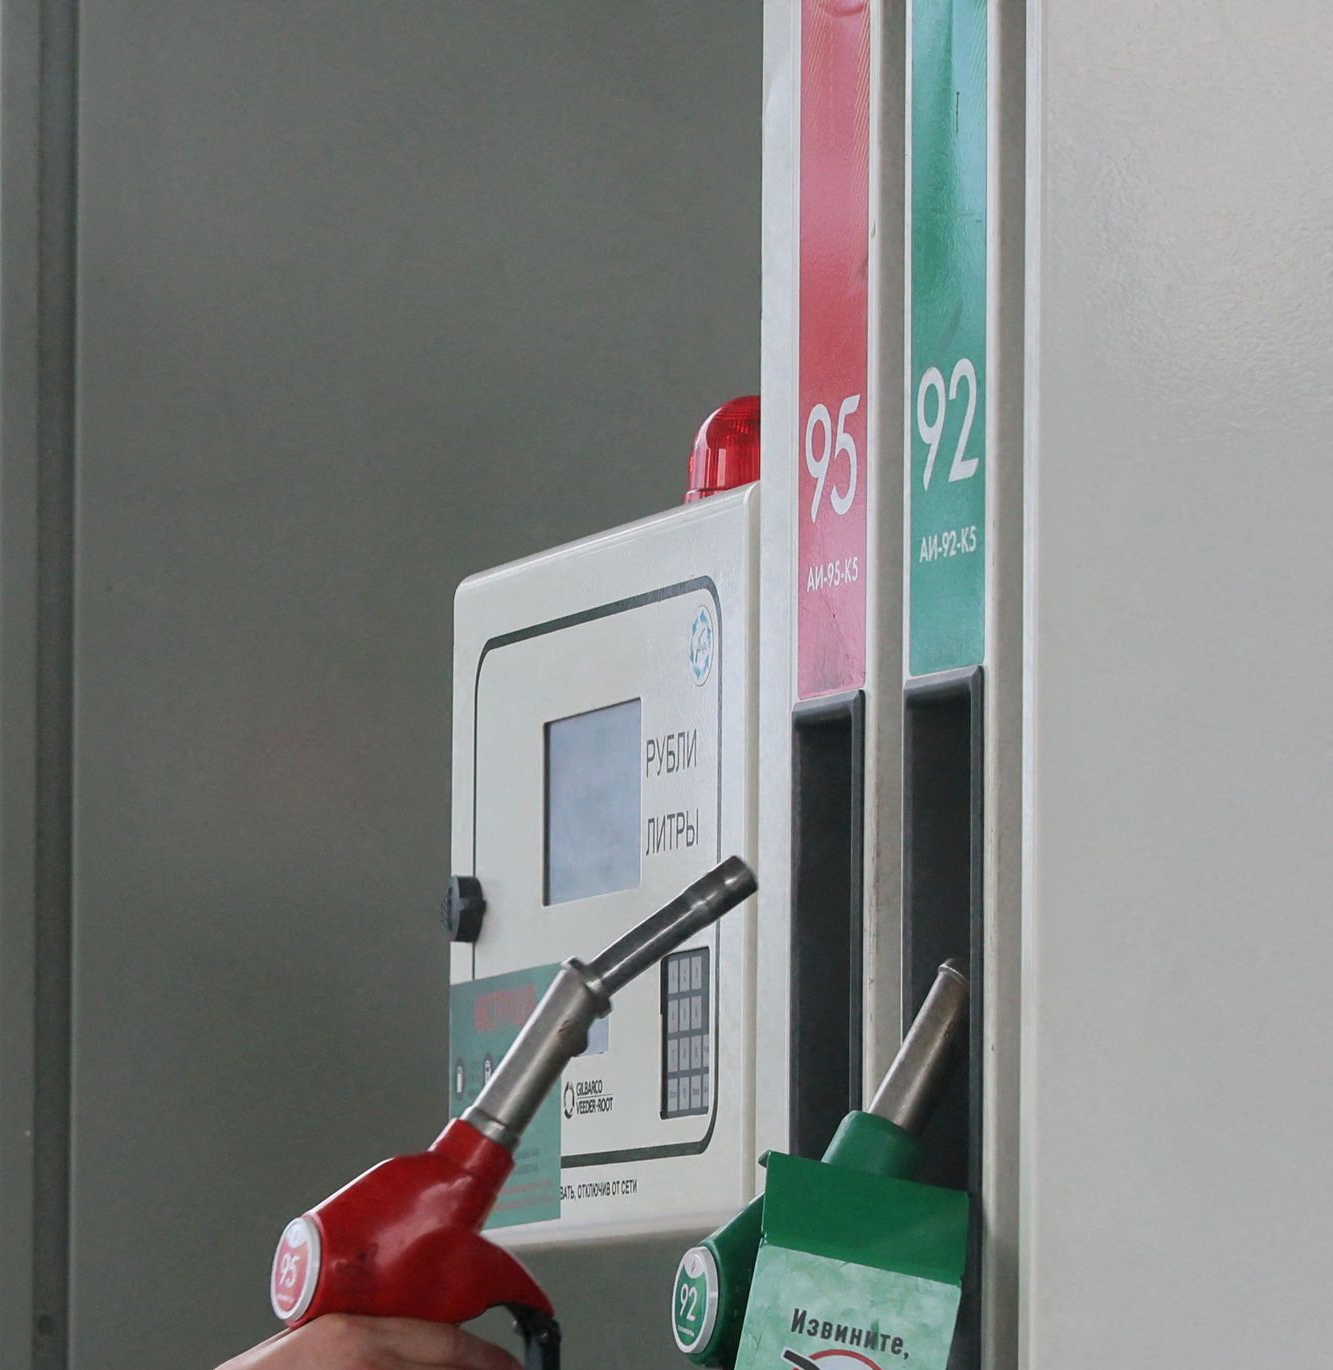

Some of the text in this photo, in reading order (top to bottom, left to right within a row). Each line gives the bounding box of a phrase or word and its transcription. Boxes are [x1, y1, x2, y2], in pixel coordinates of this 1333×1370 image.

[917, 358, 979, 491] 92
[805, 394, 861, 524] 95
[919, 526, 977, 563] АИ-92-К5
[807, 556, 859, 592] АИ-95-К5
[646, 728, 698, 779] РУБЛИ
[645, 808, 699, 857] ЛИТРЫ
[576, 1079, 603, 1096] GILBARCO
[576, 1097, 613, 1115] VEEDER-ROOT
[577, 1181, 611, 1199] ОТКЛЮЧИВ
[611, 1180, 621, 1196] ОТ
[621, 1179, 638, 1195] СЕТИ
[279, 1252, 300, 1288] 95
[680, 1283, 697, 1321] 92
[790, 1308, 910, 1360] Извините,
